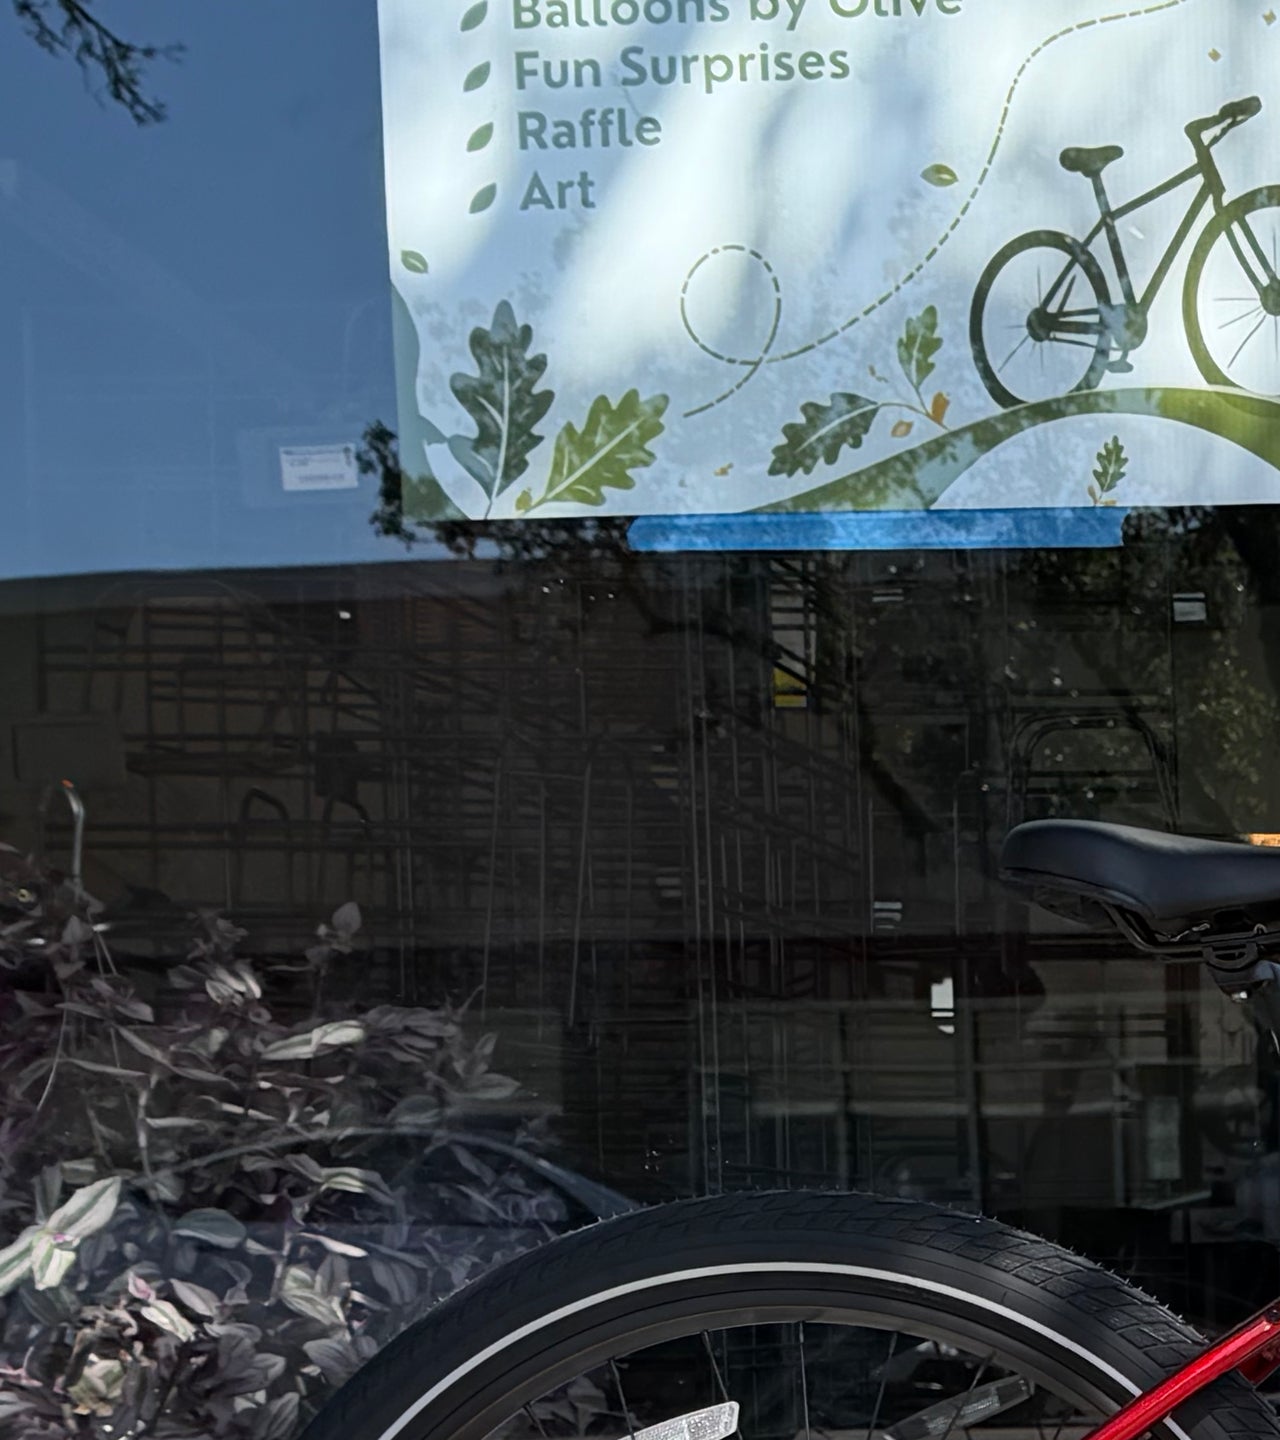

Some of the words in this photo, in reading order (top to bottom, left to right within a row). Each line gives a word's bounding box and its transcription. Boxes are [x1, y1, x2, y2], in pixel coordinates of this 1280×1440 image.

[513, 0, 730, 30] Balloons
[514, 49, 602, 91] Fun
[619, 42, 850, 95] Surprises
[516, 108, 662, 151] Raffle
[518, 170, 597, 212] Art
